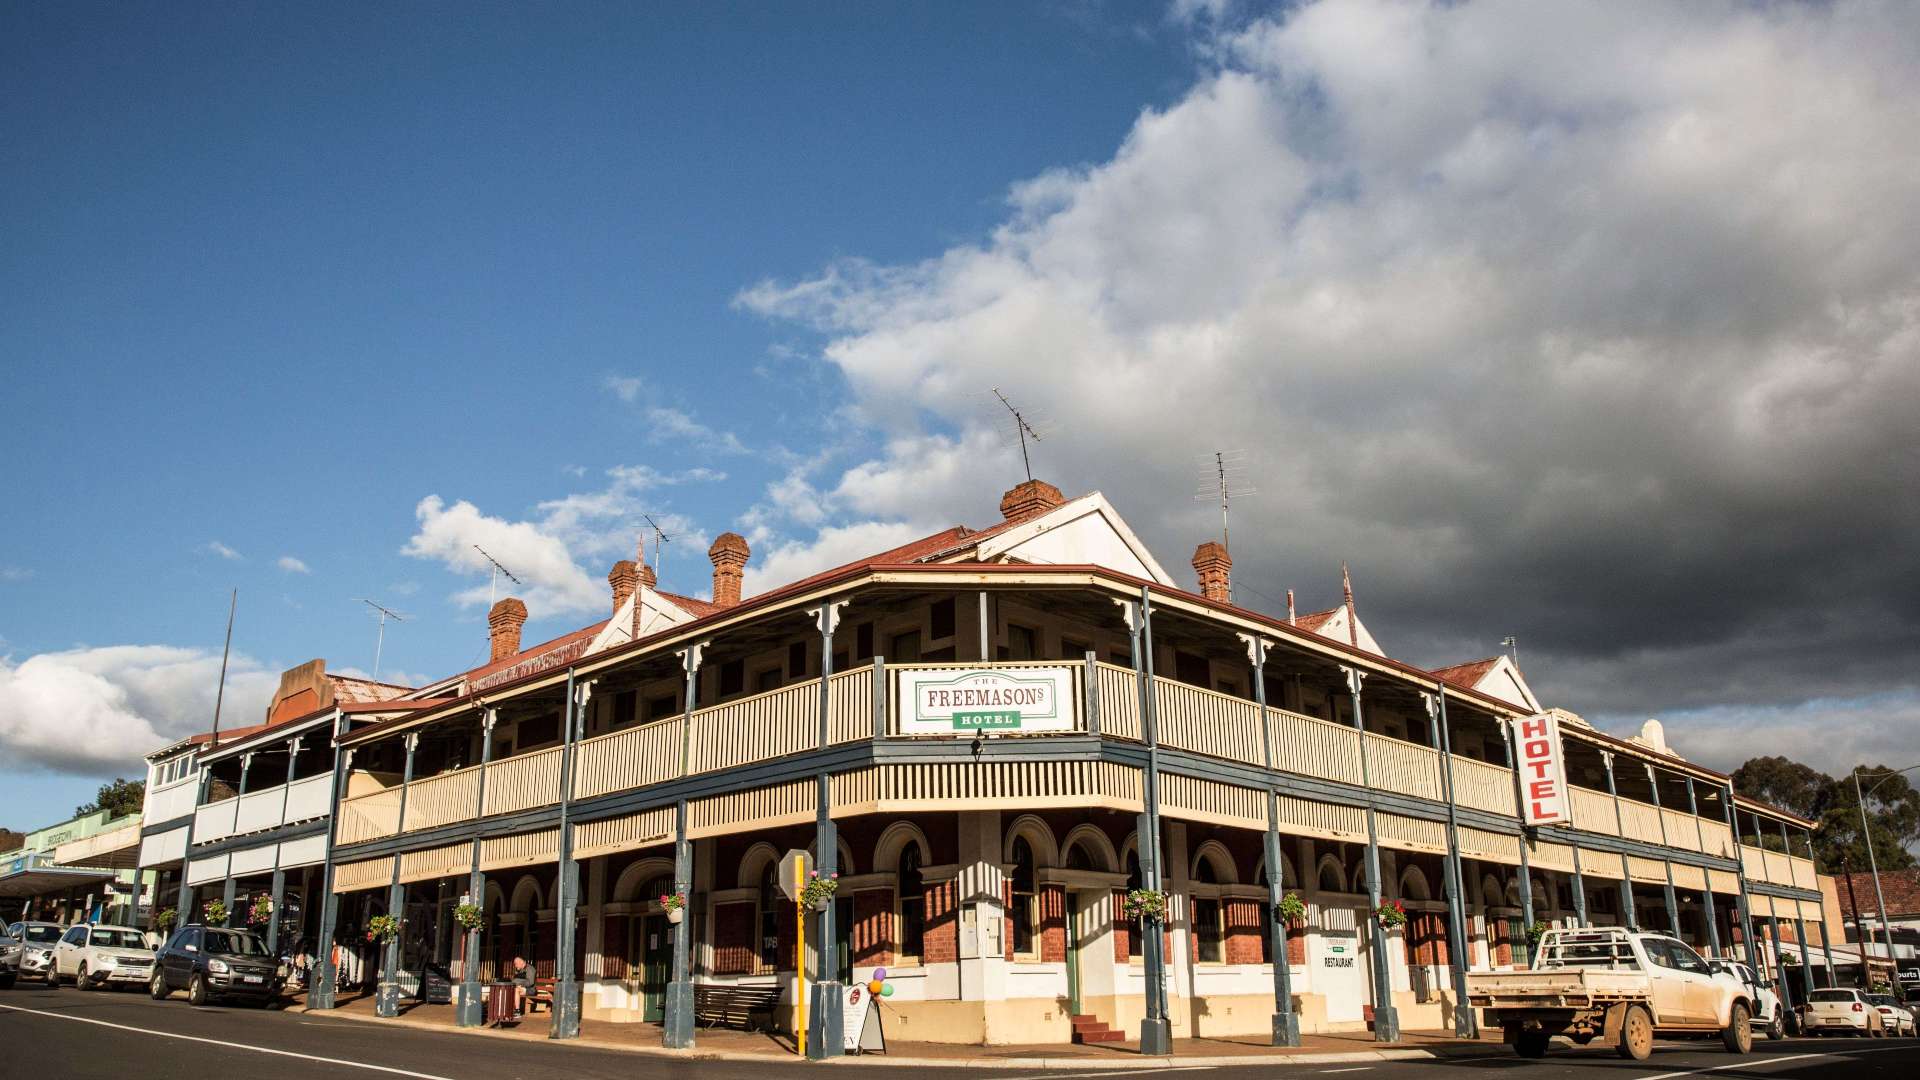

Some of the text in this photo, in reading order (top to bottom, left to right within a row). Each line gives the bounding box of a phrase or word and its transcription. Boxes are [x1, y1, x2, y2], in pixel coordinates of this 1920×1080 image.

[928, 688, 1044, 707] FREEMASONS
[962, 715, 1013, 725] HOTEL
[1522, 719, 1558, 819] HOTEL
[763, 936, 778, 949] TAB
[1324, 957, 1354, 968] RESTAURANT
